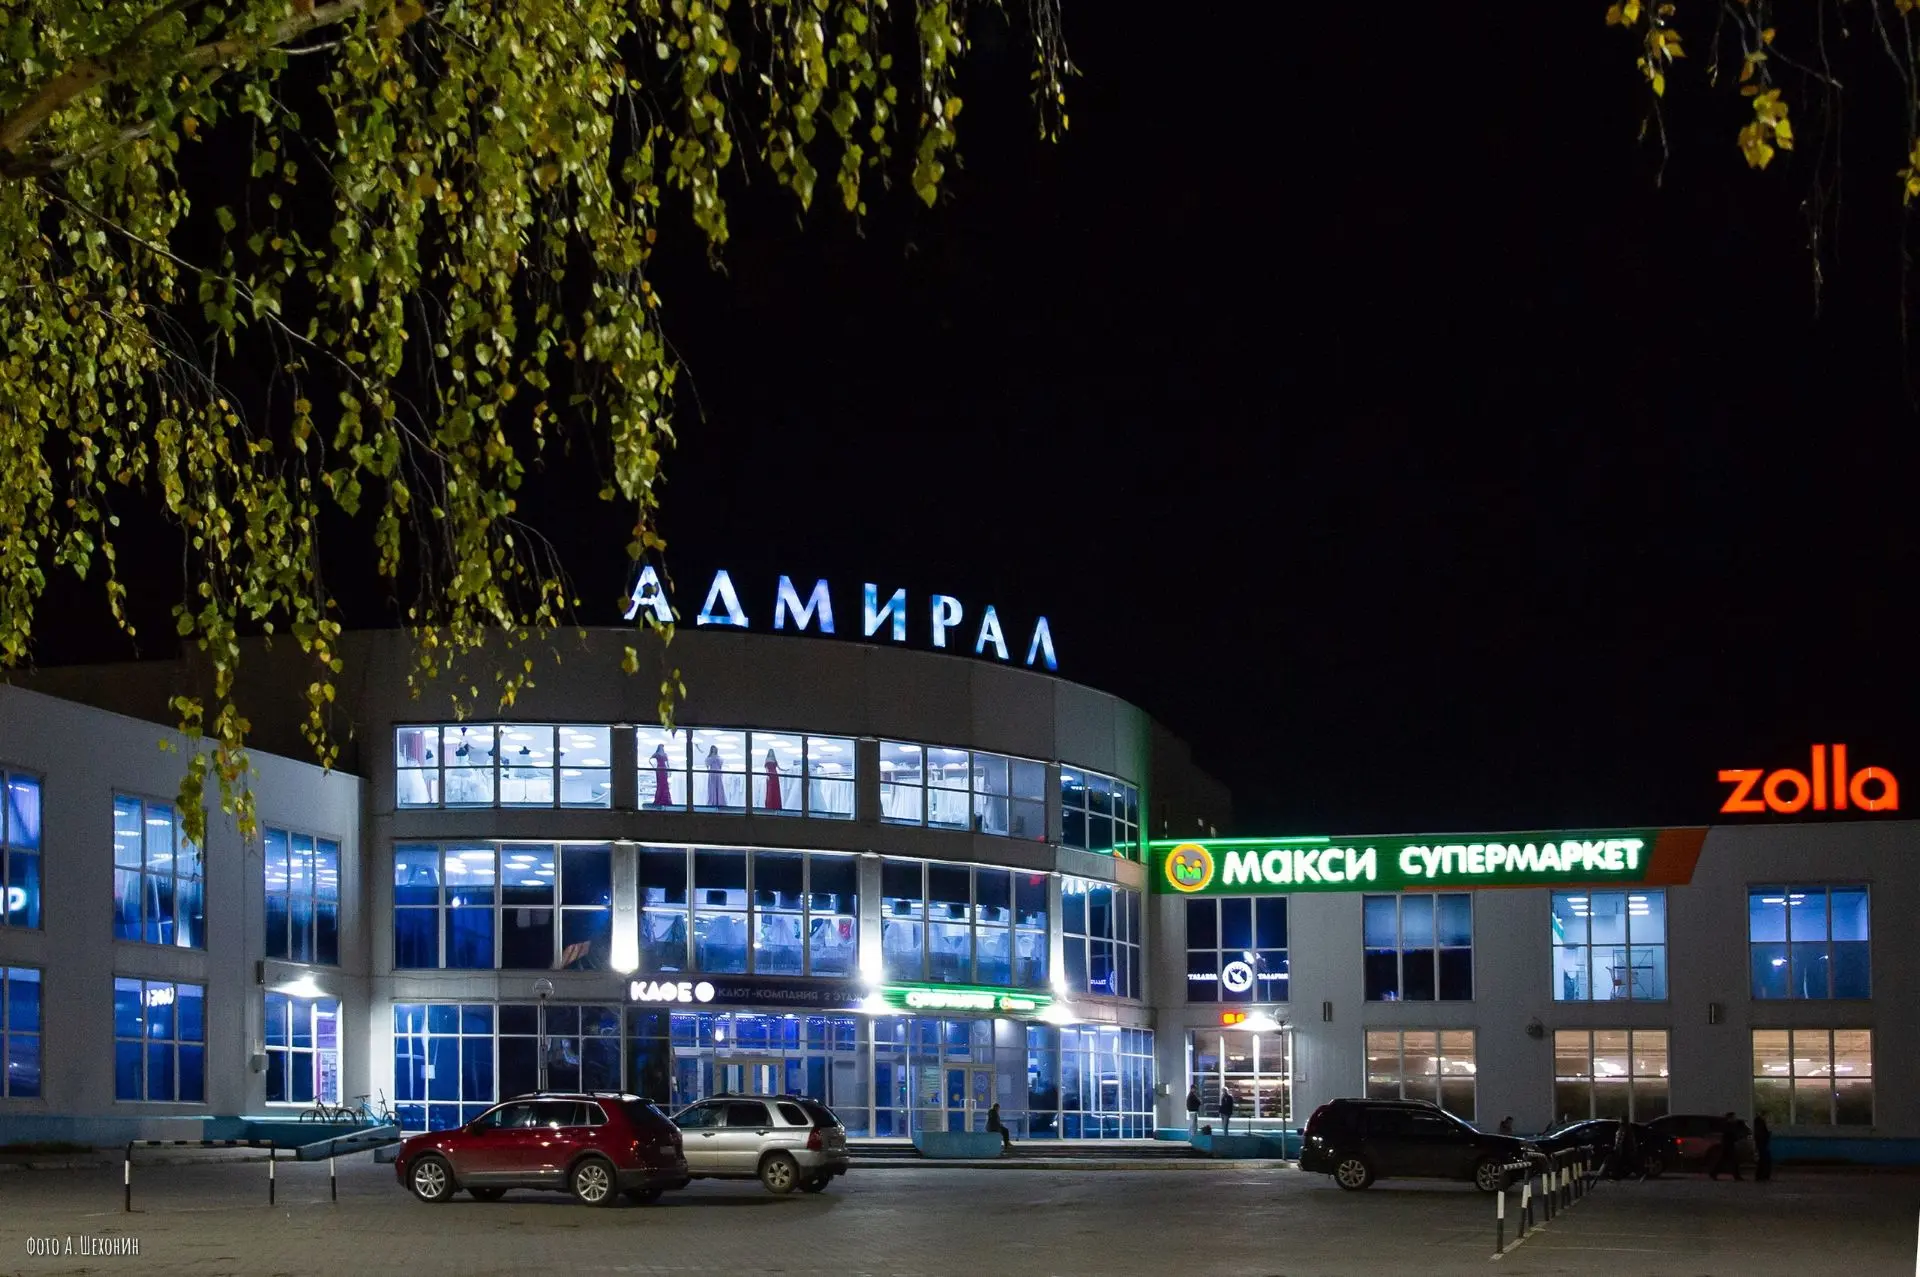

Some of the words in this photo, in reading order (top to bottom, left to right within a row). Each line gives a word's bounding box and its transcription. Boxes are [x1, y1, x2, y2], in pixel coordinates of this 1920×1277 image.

[624, 565, 1058, 671] АДМИРАЛ
[1717, 743, 1899, 813] zolla
[1399, 838, 1644, 878] СУПЕРМАРКЕТ
[630, 981, 693, 1003] КАФЕ
